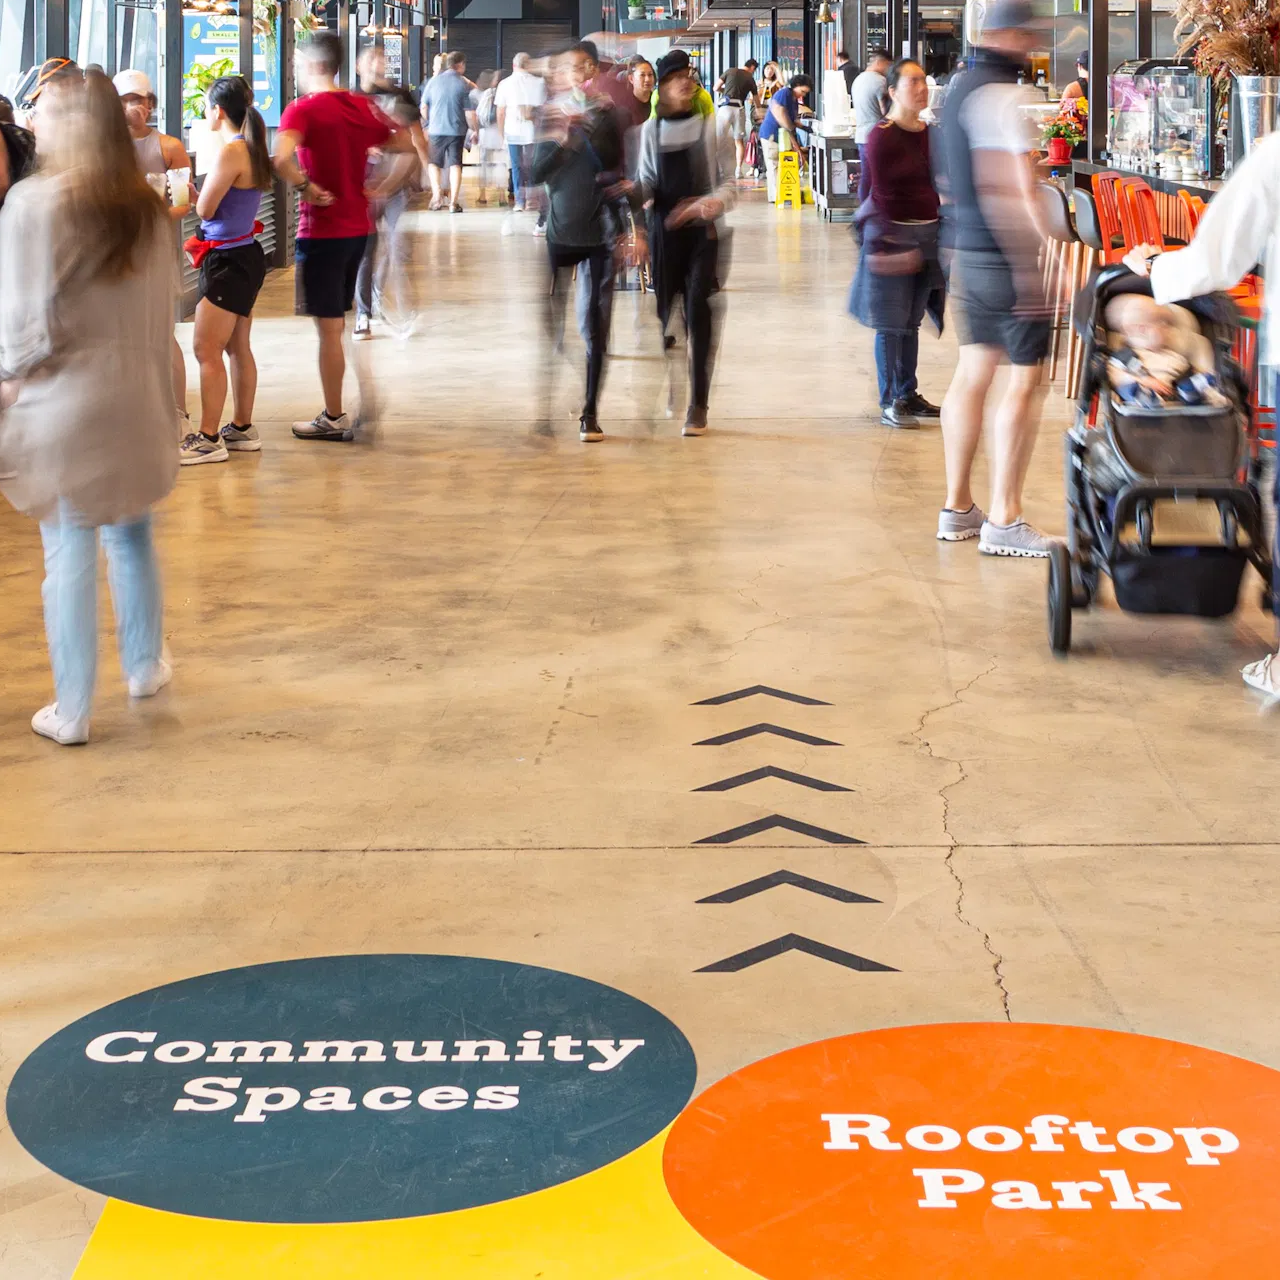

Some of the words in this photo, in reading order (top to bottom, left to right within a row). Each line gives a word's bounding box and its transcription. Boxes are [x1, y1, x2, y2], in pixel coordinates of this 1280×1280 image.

[85, 1031, 645, 1074] Community
[173, 1076, 521, 1124] Spaces
[820, 1112, 1240, 1167] Rooftop
[913, 1166, 1182, 1212] Park
